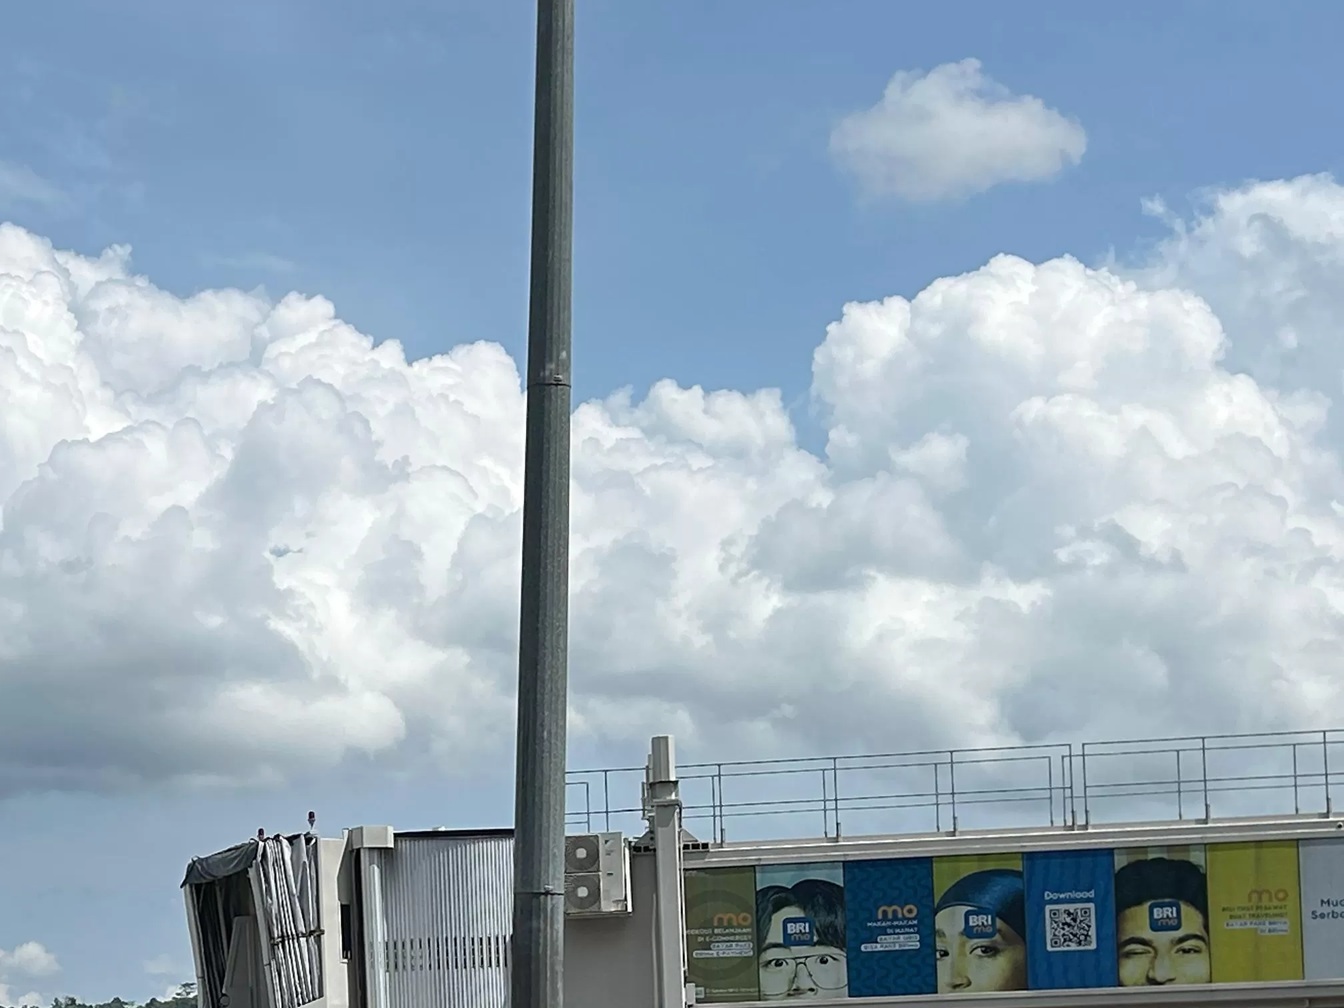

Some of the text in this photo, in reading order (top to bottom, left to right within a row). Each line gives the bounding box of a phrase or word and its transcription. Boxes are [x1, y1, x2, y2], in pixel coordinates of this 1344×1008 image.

[1044, 889, 1095, 900] Download
[1248, 888, 1289, 903] mo
[878, 904, 918, 919] mo
[1153, 907, 1176, 920] BRI
[713, 913, 752, 926] mo
[969, 914, 992, 927] BRI
[787, 922, 809, 934] BRI
